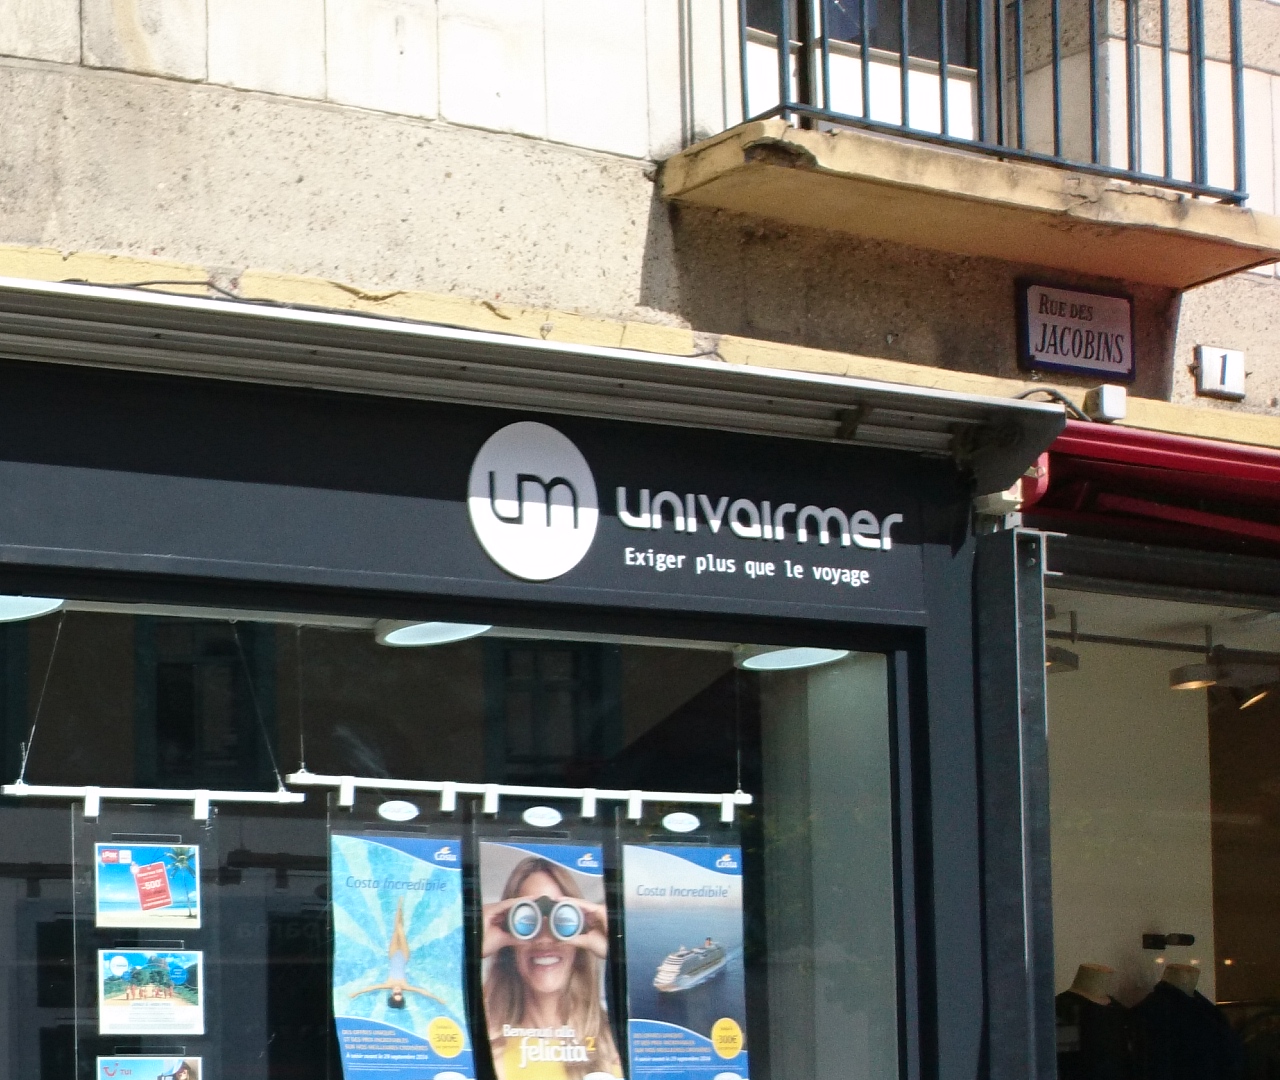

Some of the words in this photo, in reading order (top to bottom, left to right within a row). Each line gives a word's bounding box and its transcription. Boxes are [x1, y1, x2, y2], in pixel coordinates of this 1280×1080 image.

[1035, 323, 1124, 364] JACOBINS
[1219, 354, 1228, 386] 1
[616, 486, 904, 551] univairmer
[624, 547, 686, 572] Exiger
[695, 553, 736, 575] plus
[745, 561, 775, 579] que
[785, 560, 804, 579] le
[812, 565, 870, 587] voyage
[434, 851, 457, 861] Costa
[345, 876, 379, 889] Costa
[637, 884, 666, 897] Costa
